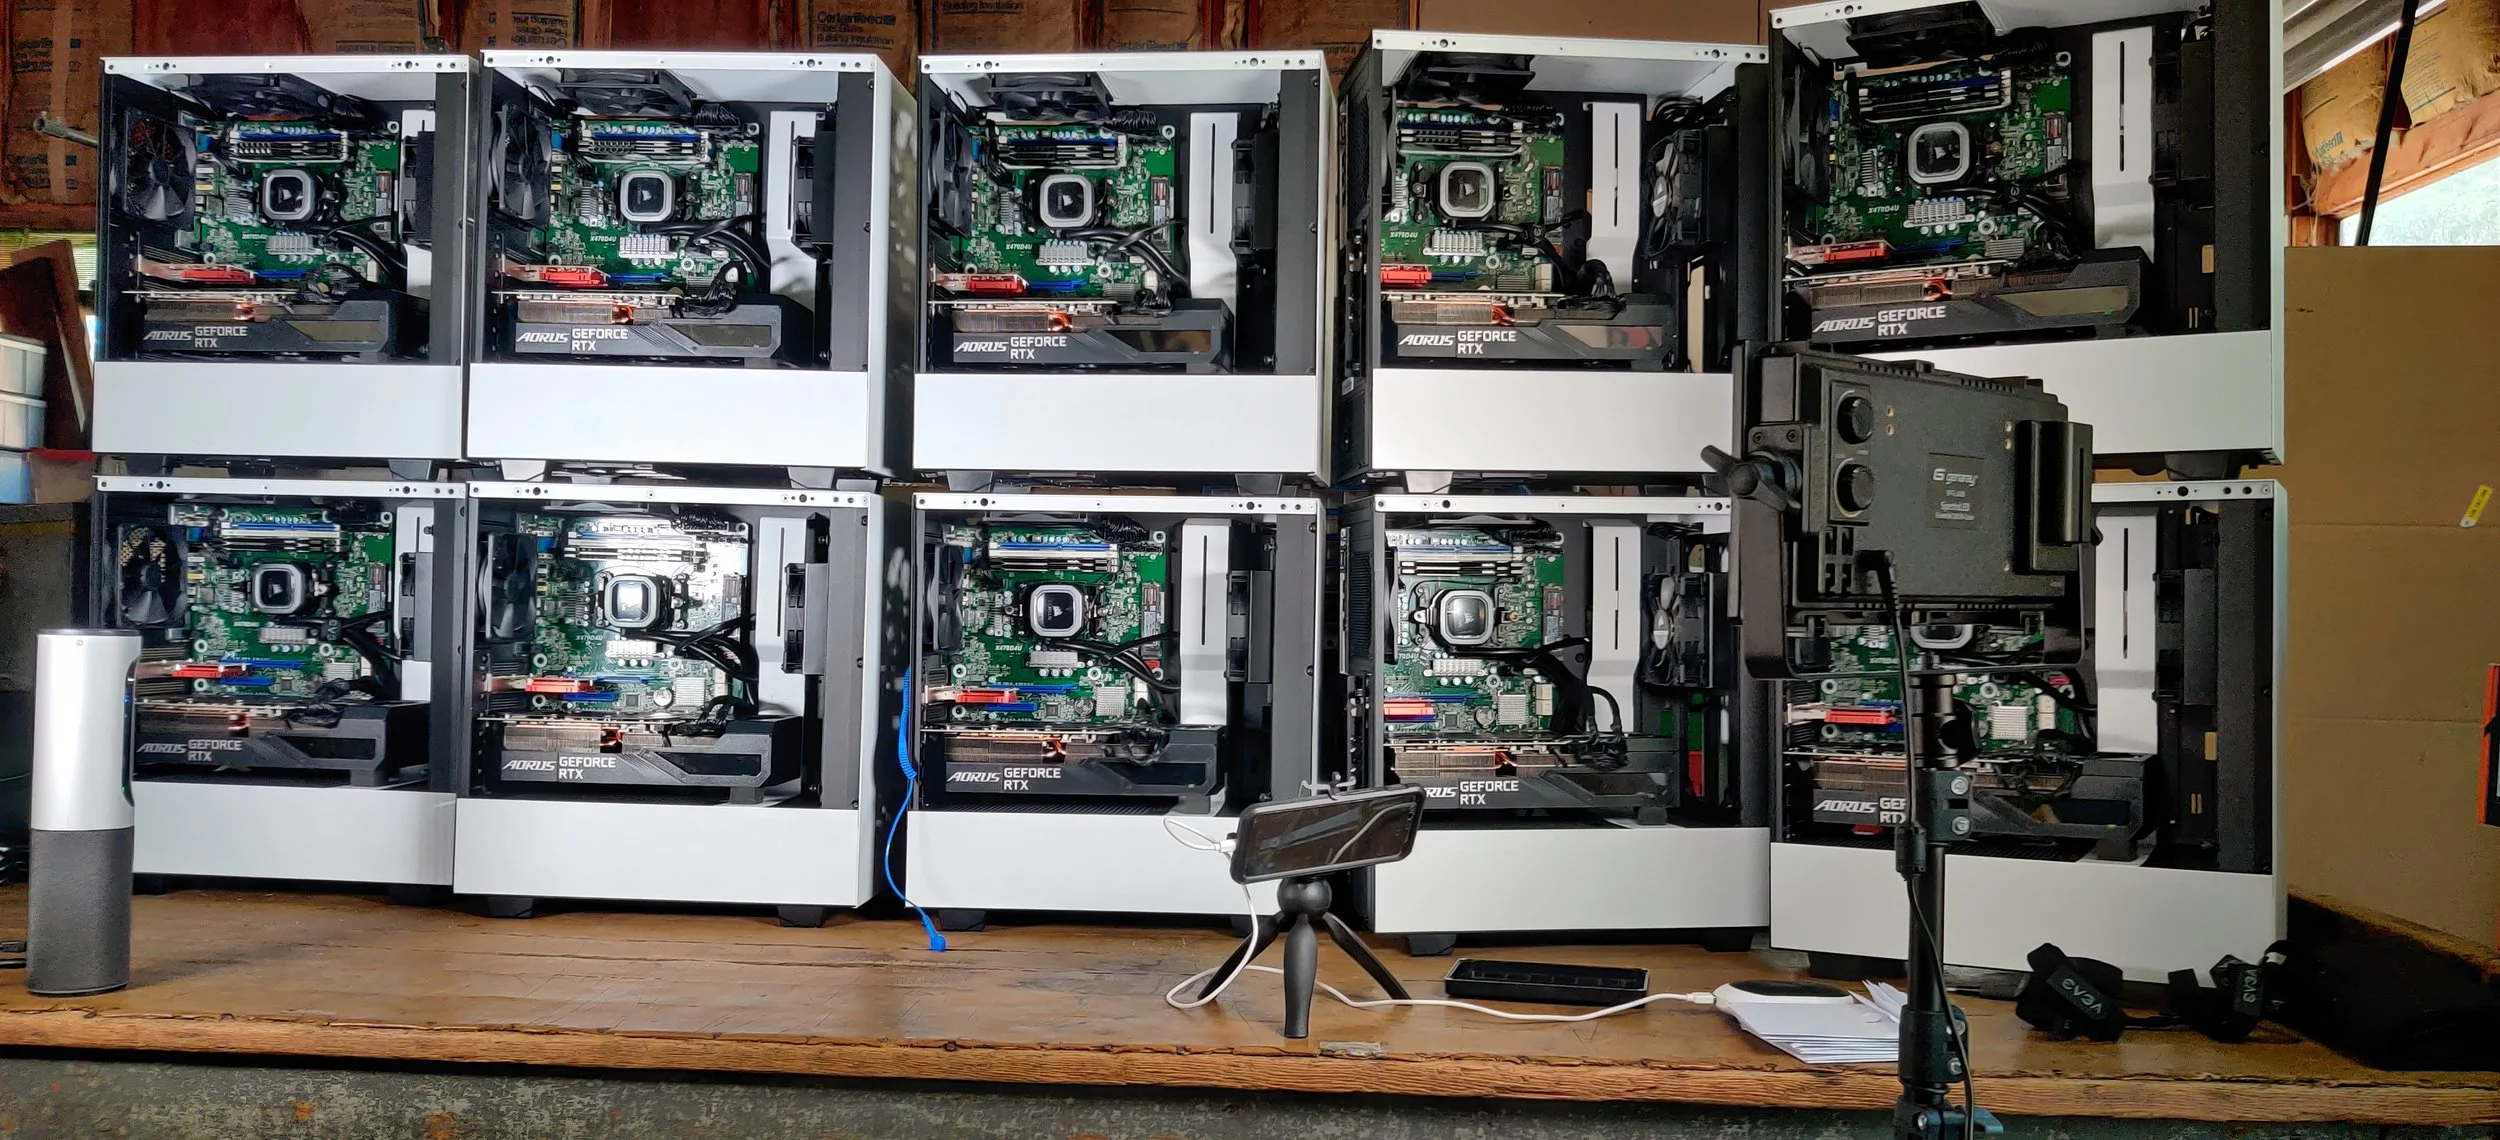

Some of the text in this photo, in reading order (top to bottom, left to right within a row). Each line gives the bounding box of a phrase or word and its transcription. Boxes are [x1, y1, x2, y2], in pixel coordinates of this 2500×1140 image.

[1877, 306, 1947, 323] GEFORCE
[1813, 317, 1877, 333] AORUS
[1877, 323, 1908, 337] RTX
[143, 331, 195, 341] AORUS
[194, 326, 248, 337] GEFORCE
[516, 332, 571, 343] AORUS
[572, 328, 629, 340] GEFORCE
[1457, 330, 1517, 342] GEFORCE
[194, 337, 218, 348] RTX
[572, 340, 597, 351] RTX
[1010, 336, 1067, 348] GEFORCE
[1399, 334, 1456, 346] AORUS
[953, 341, 1009, 352] AORUS
[1457, 343, 1484, 355] RTX
[1010, 348, 1036, 359] RTX
[136, 743, 188, 754] AORUS
[188, 739, 243, 751] GEFORCE
[187, 751, 213, 762] RTX
[558, 756, 617, 768] GEFORCE
[502, 759, 557, 771] AORUS
[558, 768, 584, 780] RTX
[947, 771, 1001, 783] AORUS
[1003, 767, 1062, 779] GEFORCE
[1003, 779, 1029, 791] RTX
[1459, 780, 1520, 792] GEFORCE
[1424, 787, 1459, 799] RUS
[1459, 793, 1487, 805] RTX
[1813, 799, 1879, 814] AORUS
